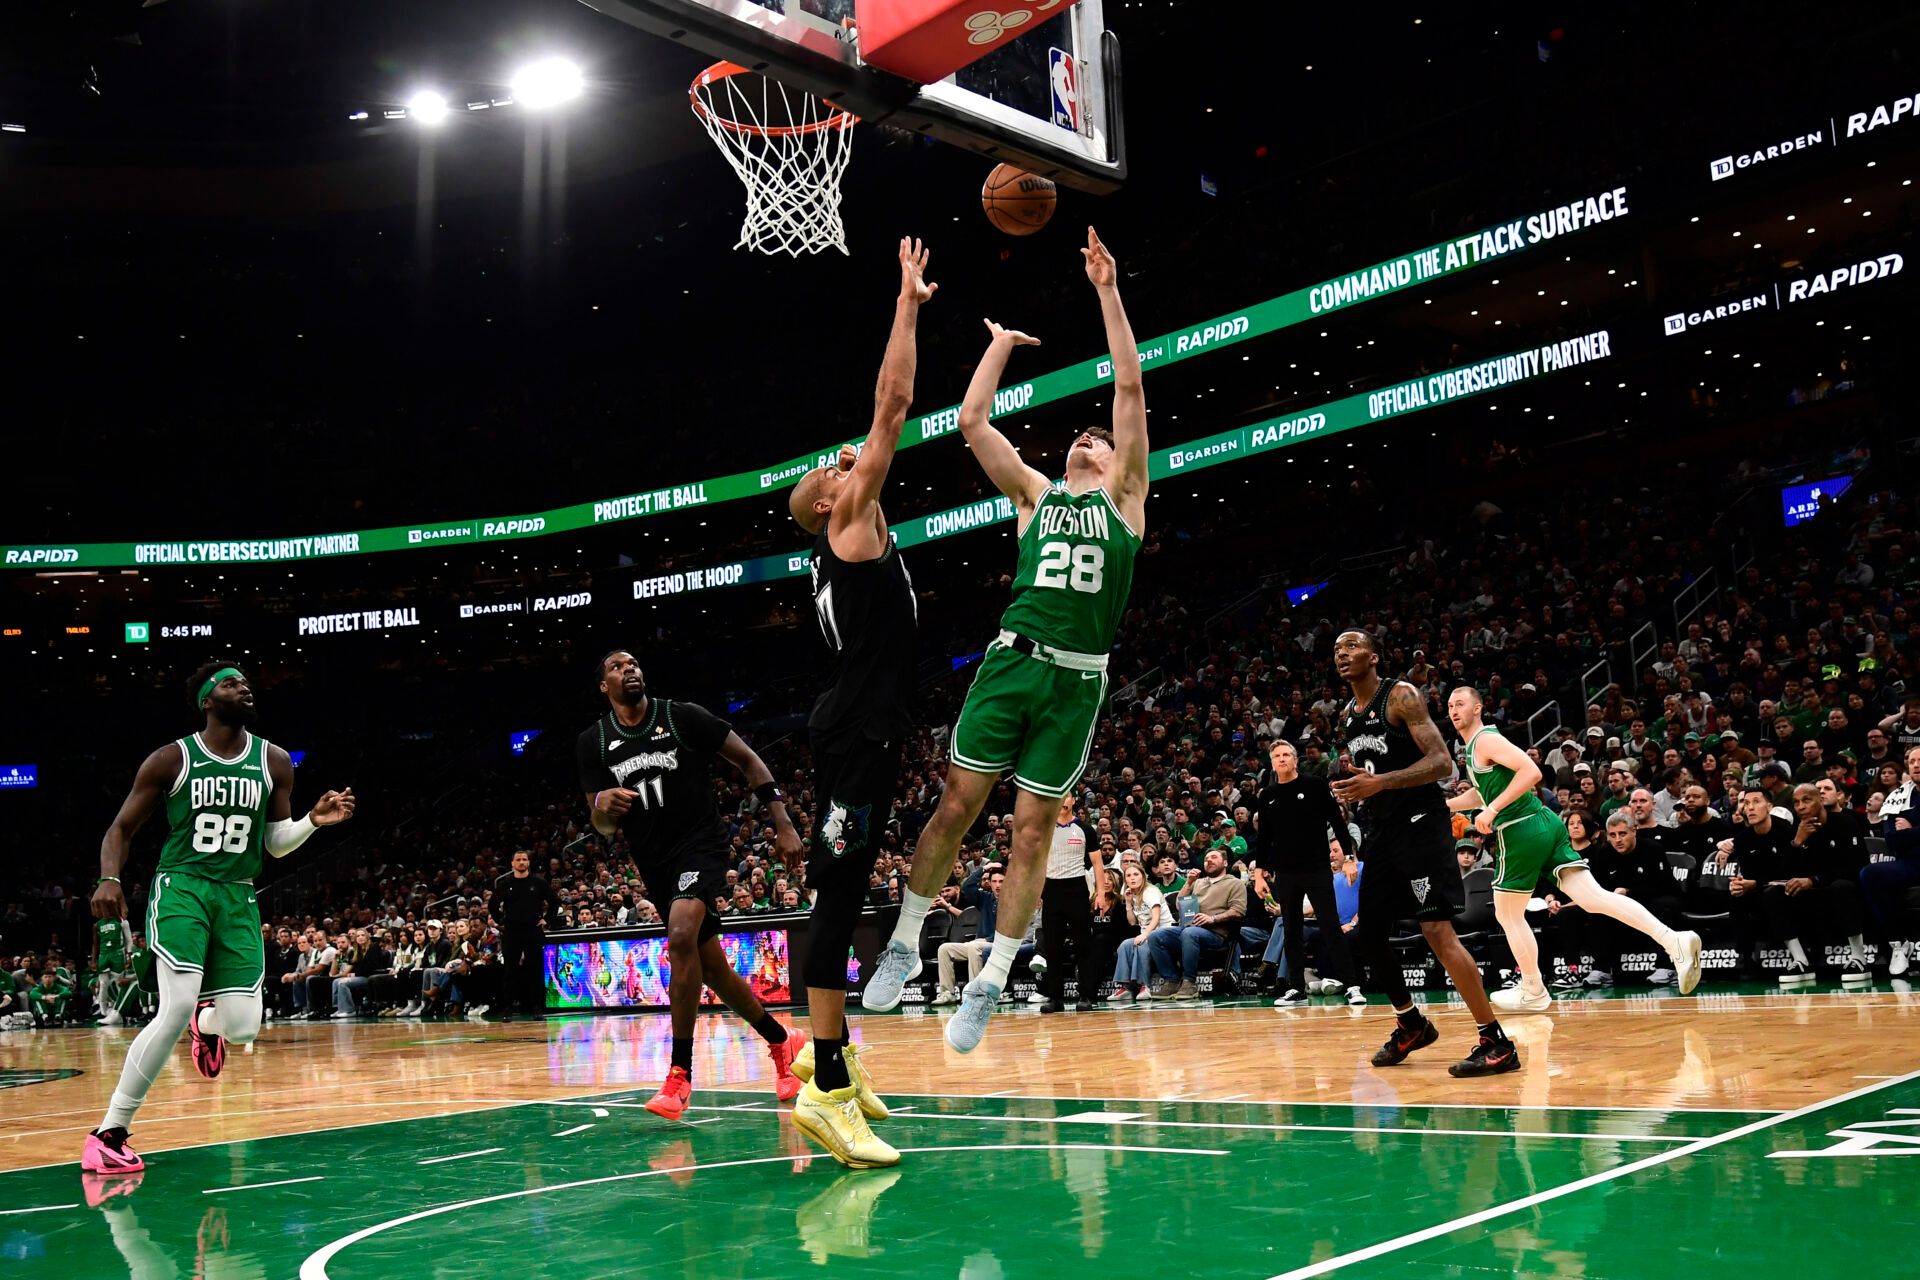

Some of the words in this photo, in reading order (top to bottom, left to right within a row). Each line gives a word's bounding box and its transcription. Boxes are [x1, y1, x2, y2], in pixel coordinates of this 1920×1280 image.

[1712, 158, 1733, 179] TD
[1736, 131, 1822, 169] GARDEN
[1309, 259, 1411, 313] COMMAND
[1413, 247, 1441, 280] THE
[1445, 220, 1525, 272] ATTACK
[1526, 187, 1628, 243] SURFACE
[1666, 315, 1685, 334] TD
[1687, 295, 1767, 326] GARDEN
[1368, 381, 1428, 419] OFFICIAL
[1428, 349, 1540, 404] CYBERSECURITY
[1541, 330, 1611, 373] PARTNER
[921, 405, 962, 439] DEFEN
[994, 383, 1034, 416] HOOP
[1185, 439, 1238, 462] GARDEN
[772, 464, 808, 482] GARDEN
[594, 493, 652, 522] PROTECT
[653, 491, 672, 511] THE
[673, 483, 707, 507] BALL
[925, 502, 994, 538] COMMAND
[995, 497, 1014, 518] THE
[1038, 505, 1110, 541] BOSTON
[423, 527, 471, 540] GARDEN
[135, 543, 187, 563] OFFICIAL
[188, 538, 314, 562] CYBERSECURITY
[314, 533, 360, 556] PARTNER
[1033, 541, 1105, 594] 28
[633, 573, 684, 600] DEFEND
[686, 569, 704, 591] THE
[705, 564, 744, 587] HOOP
[298, 613, 361, 635] PROTECT
[362, 610, 382, 630] THE
[384, 607, 420, 627] BALL
[474, 602, 522, 615] GARDEN
[126, 624, 147, 640] TD
[161, 626, 189, 638] 8:45
[191, 625, 212, 637] PM
[191, 776, 262, 811] BOSTON
[632, 774, 664, 810] 11
[192, 812, 253, 854] 88
[1620, 953, 1658, 963] BOSTO
[1700, 950, 1739, 959] OSTON
[1759, 950, 1792, 959] BOST
[1824, 944, 1878, 955] BOSON
[1621, 961, 1657, 972] CELTIC
[1700, 958, 1737, 968] ELTICS
[1761, 958, 1792, 968] CELT
[901, 987, 922, 995] BOSTO
[901, 994, 925, 1002] CELTIC
[1013, 983, 1037, 991] BOSTO
